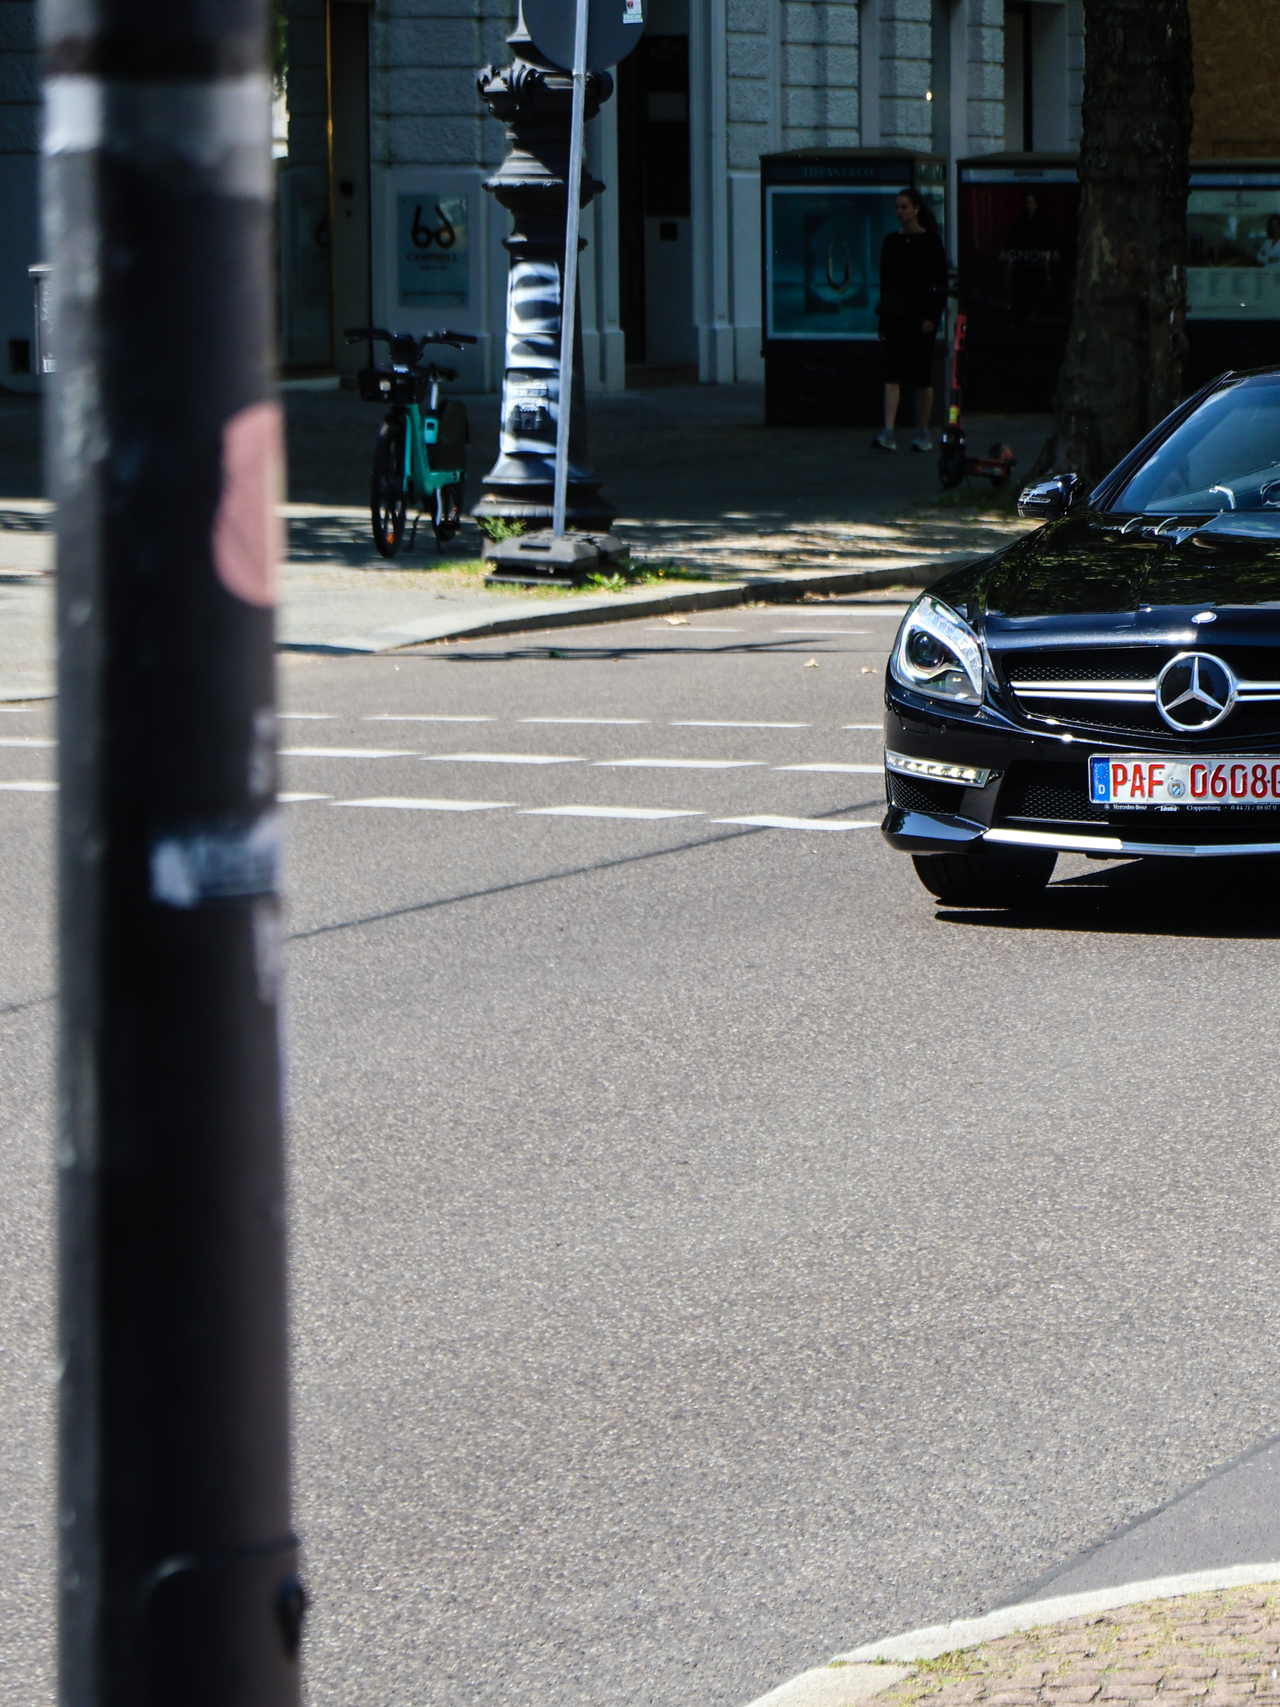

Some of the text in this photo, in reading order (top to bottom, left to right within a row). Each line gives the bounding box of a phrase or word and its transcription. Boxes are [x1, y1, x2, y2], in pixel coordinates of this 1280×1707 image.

[998, 250, 1060, 262] AGNONA
[1111, 763, 1166, 798] PAF
[1098, 784, 1106, 795] D
